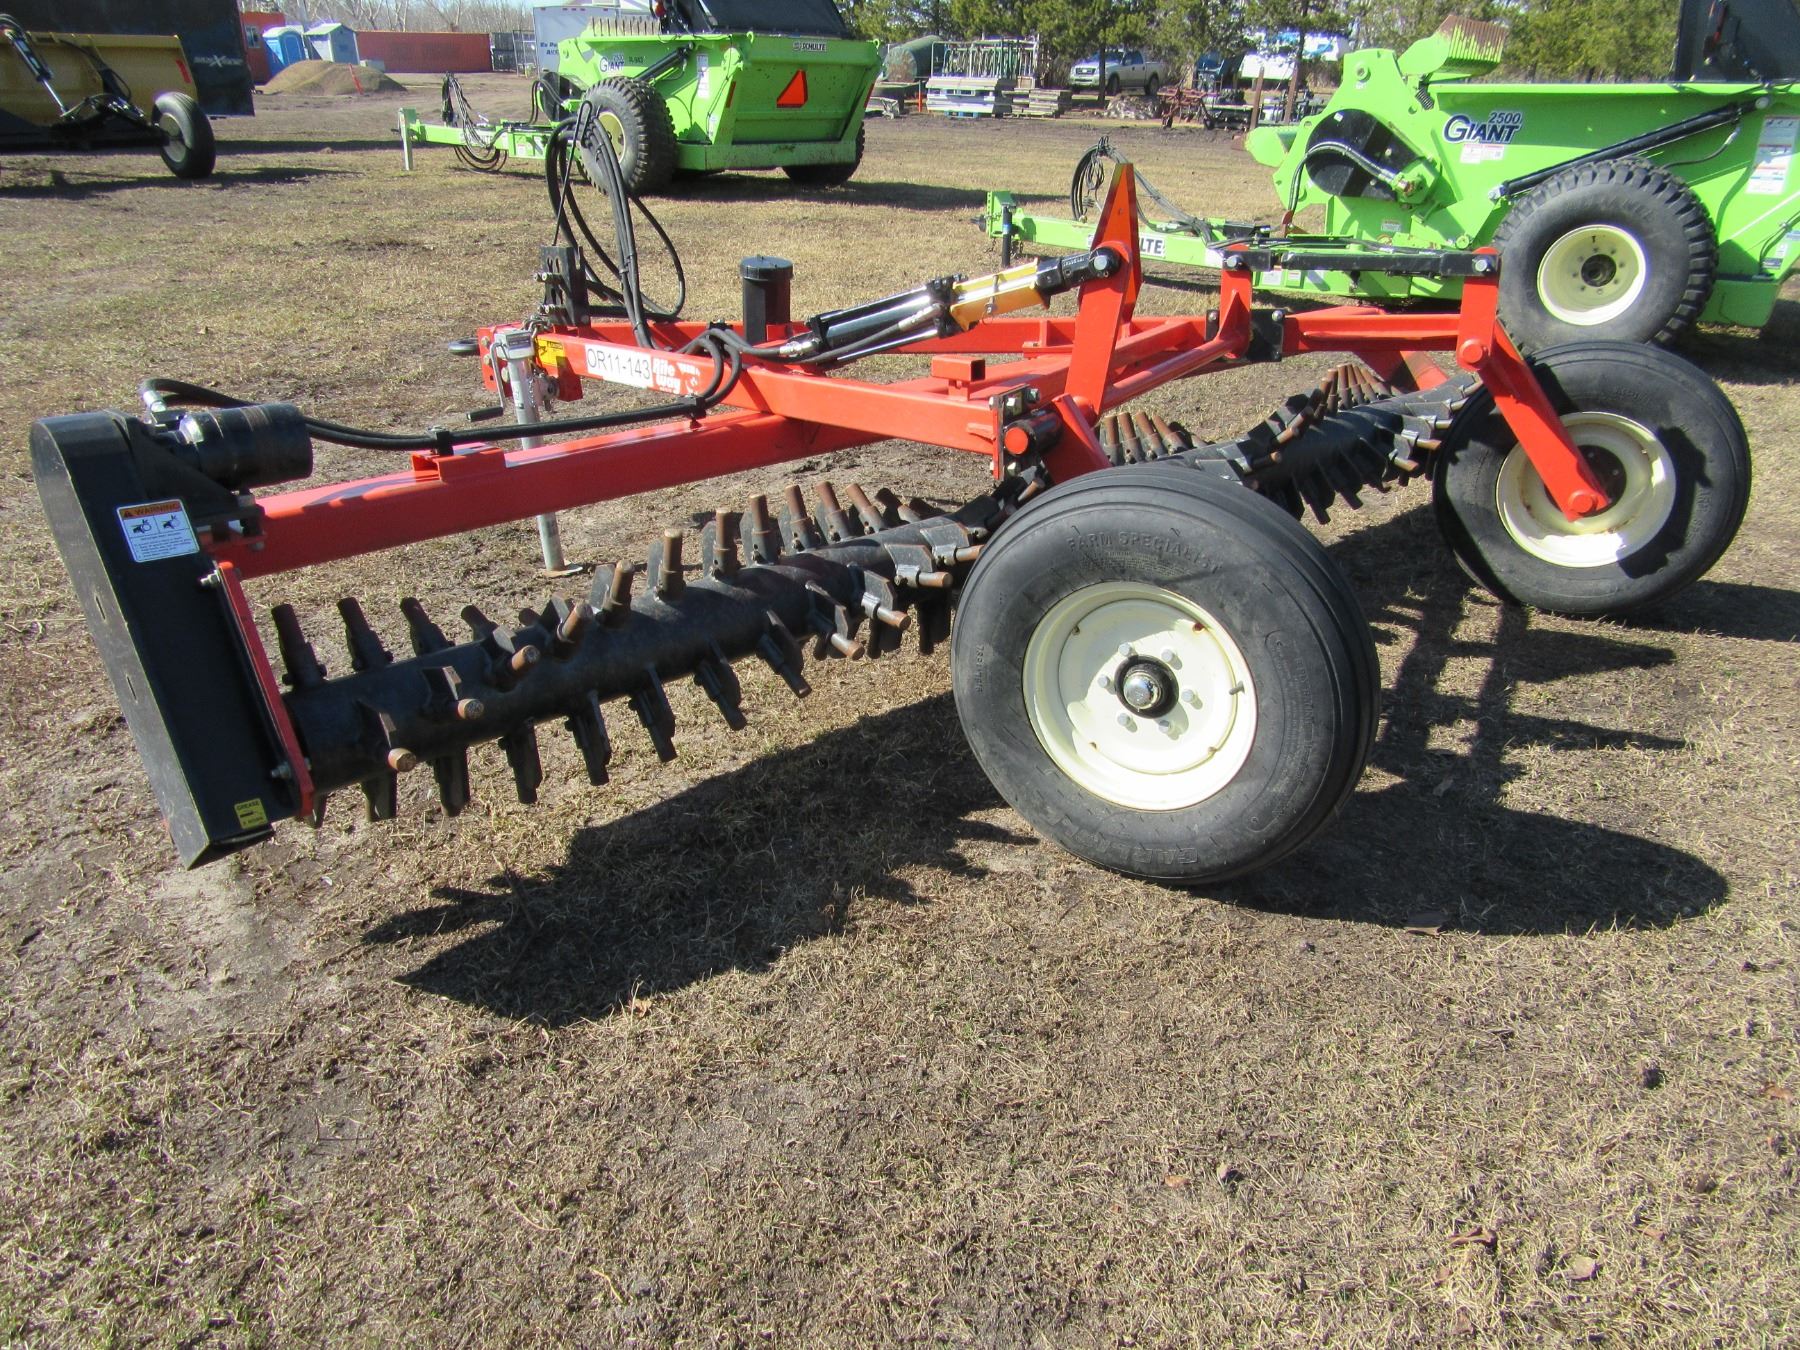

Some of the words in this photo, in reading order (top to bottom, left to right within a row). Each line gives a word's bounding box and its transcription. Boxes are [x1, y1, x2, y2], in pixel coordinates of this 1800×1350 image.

[802, 42, 826, 50] SCHULTE
[600, 57, 624, 72] GIANT
[1489, 112, 1521, 124] 2500
[1444, 115, 1519, 143] GIANT
[586, 348, 650, 380] OR11-143
[1066, 532, 1113, 550] FARM
